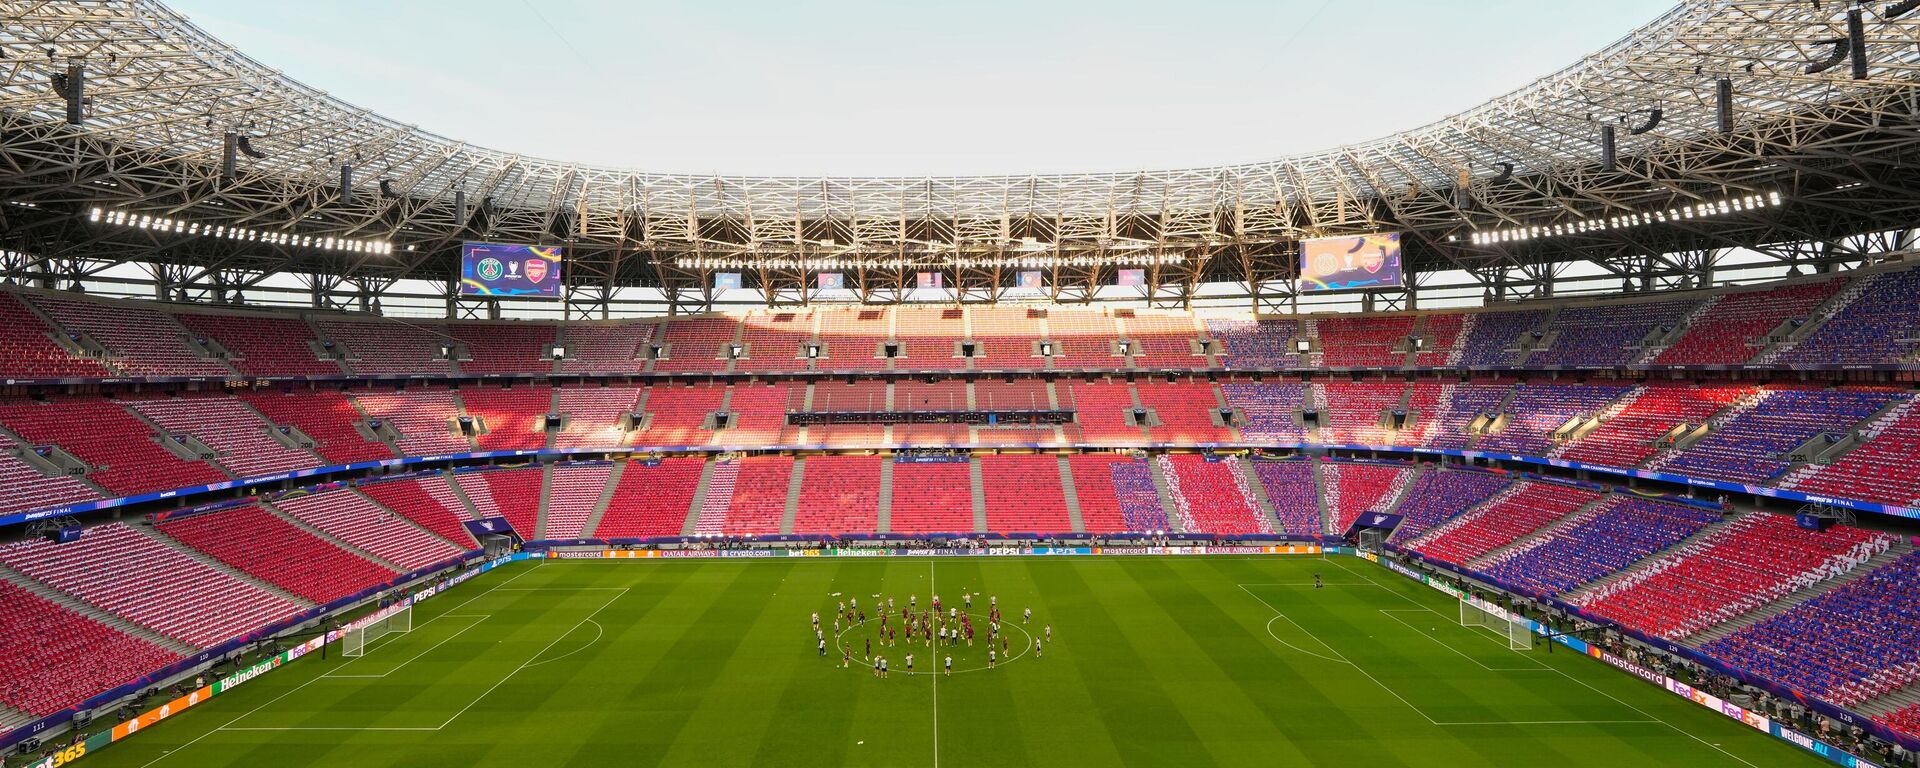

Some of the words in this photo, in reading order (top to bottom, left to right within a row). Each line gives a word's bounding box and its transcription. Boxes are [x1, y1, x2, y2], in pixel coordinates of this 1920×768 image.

[1833, 498, 1854, 507] FINAL
[53, 507, 71, 515] FINAL
[559, 550, 601, 558] mastercard
[729, 550, 770, 558] crypto.com
[836, 548, 877, 556] Heineken
[1356, 549, 1378, 563] bet365
[455, 568, 480, 584] crypto.com
[1394, 564, 1420, 580] crypto.com
[1428, 577, 1458, 597] Heineken
[414, 586, 436, 604] PEPSI
[355, 614, 374, 629] QATAR
[293, 641, 316, 659] FedEx
[1668, 644, 1678, 652] 129
[200, 653, 209, 661] 110
[1603, 652, 1663, 685] mastercard
[220, 661, 272, 692] Heineken
[1673, 679, 1706, 705] FedEx
[1722, 699, 1760, 730] FedEx
[1840, 712, 1853, 723] 128
[33, 722, 45, 732] 111
[1780, 727, 1814, 751] WELCOME
[1813, 742, 1828, 757] ALL
